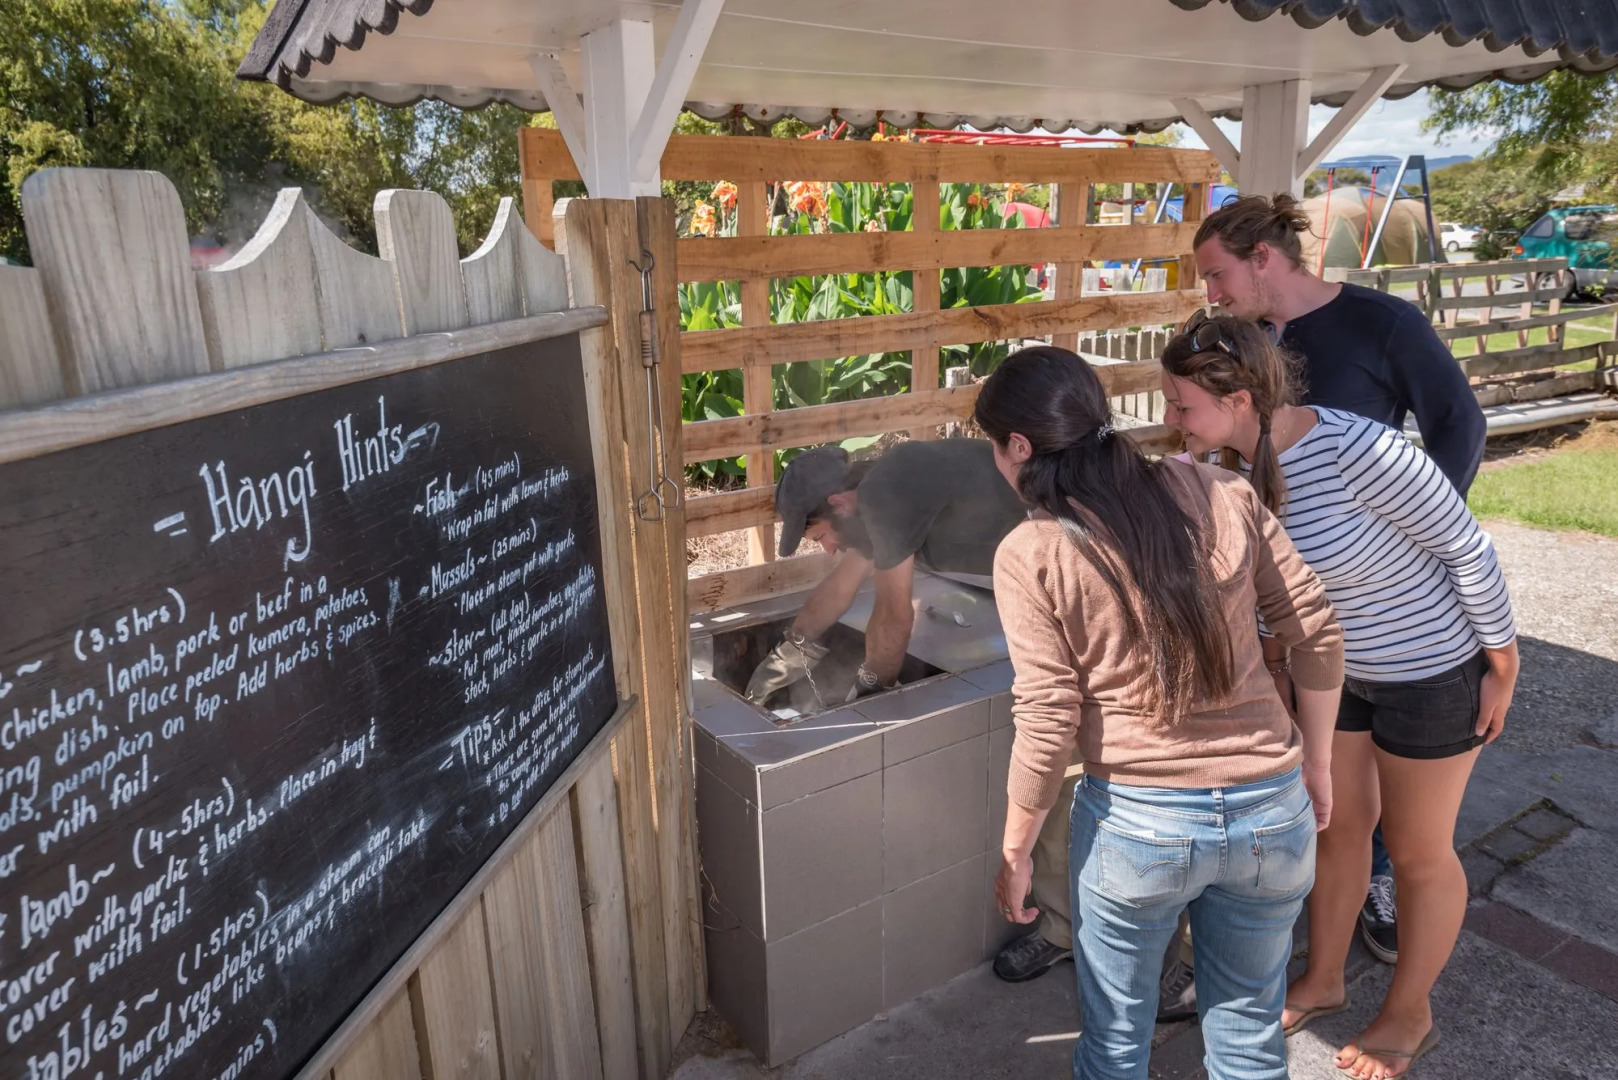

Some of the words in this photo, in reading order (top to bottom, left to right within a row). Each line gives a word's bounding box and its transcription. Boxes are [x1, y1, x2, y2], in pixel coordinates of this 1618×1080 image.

[199, 451, 317, 571] Hangi
[334, 395, 403, 491] Hints
[425, 472, 457, 518] Fish
[473, 508, 482, 526] in
[483, 494, 498, 522] foil
[501, 486, 519, 513] with
[521, 480, 542, 500] lemon
[550, 465, 569, 488] herbs
[431, 548, 476, 599] Mussels
[461, 590, 483, 615] Place
[485, 579, 495, 598] in
[498, 567, 521, 591] steam
[523, 551, 536, 585] pot
[55, 715, 119, 766] dish.
[186, 644, 238, 703] peeled
[248, 616, 311, 658] kumera,
[314, 587, 368, 631] potatoes,
[107, 643, 168, 697] lamb,
[176, 612, 220, 672] pork
[228, 612, 248, 636] or
[256, 576, 294, 624] beef
[300, 581, 312, 603] in
[318, 576, 327, 594] a
[443, 628, 474, 665] Stew
[463, 653, 478, 680] Put
[465, 671, 490, 704] stock,
[493, 648, 517, 681] herbs
[550, 617, 557, 632] in
[52, 731, 153, 813] pumpkin
[162, 716, 184, 739] on
[194, 692, 228, 722] top.
[237, 661, 267, 701] Add
[275, 641, 319, 679] herbs
[491, 729, 508, 758] Ask
[508, 716, 516, 741] at
[519, 710, 530, 731] the
[553, 676, 563, 698] for
[492, 753, 515, 780] There
[516, 738, 528, 758] are
[531, 719, 548, 745] some
[37, 795, 98, 855] with
[109, 753, 159, 810] foil.
[74, 894, 126, 957] with
[129, 855, 189, 927] garlic
[214, 798, 274, 854] herbs.
[320, 758, 336, 780] in
[341, 734, 366, 769] tray
[88, 923, 142, 983] with
[150, 886, 192, 943] foil.
[119, 1002, 172, 1076] hard
[178, 923, 279, 1024] vegetables
[286, 903, 301, 932] in
[304, 891, 314, 911] a
[318, 850, 362, 898] steam
[367, 826, 390, 852] can
[232, 963, 265, 1004] like
[275, 911, 322, 965] beans
[342, 841, 395, 905] broccoli
